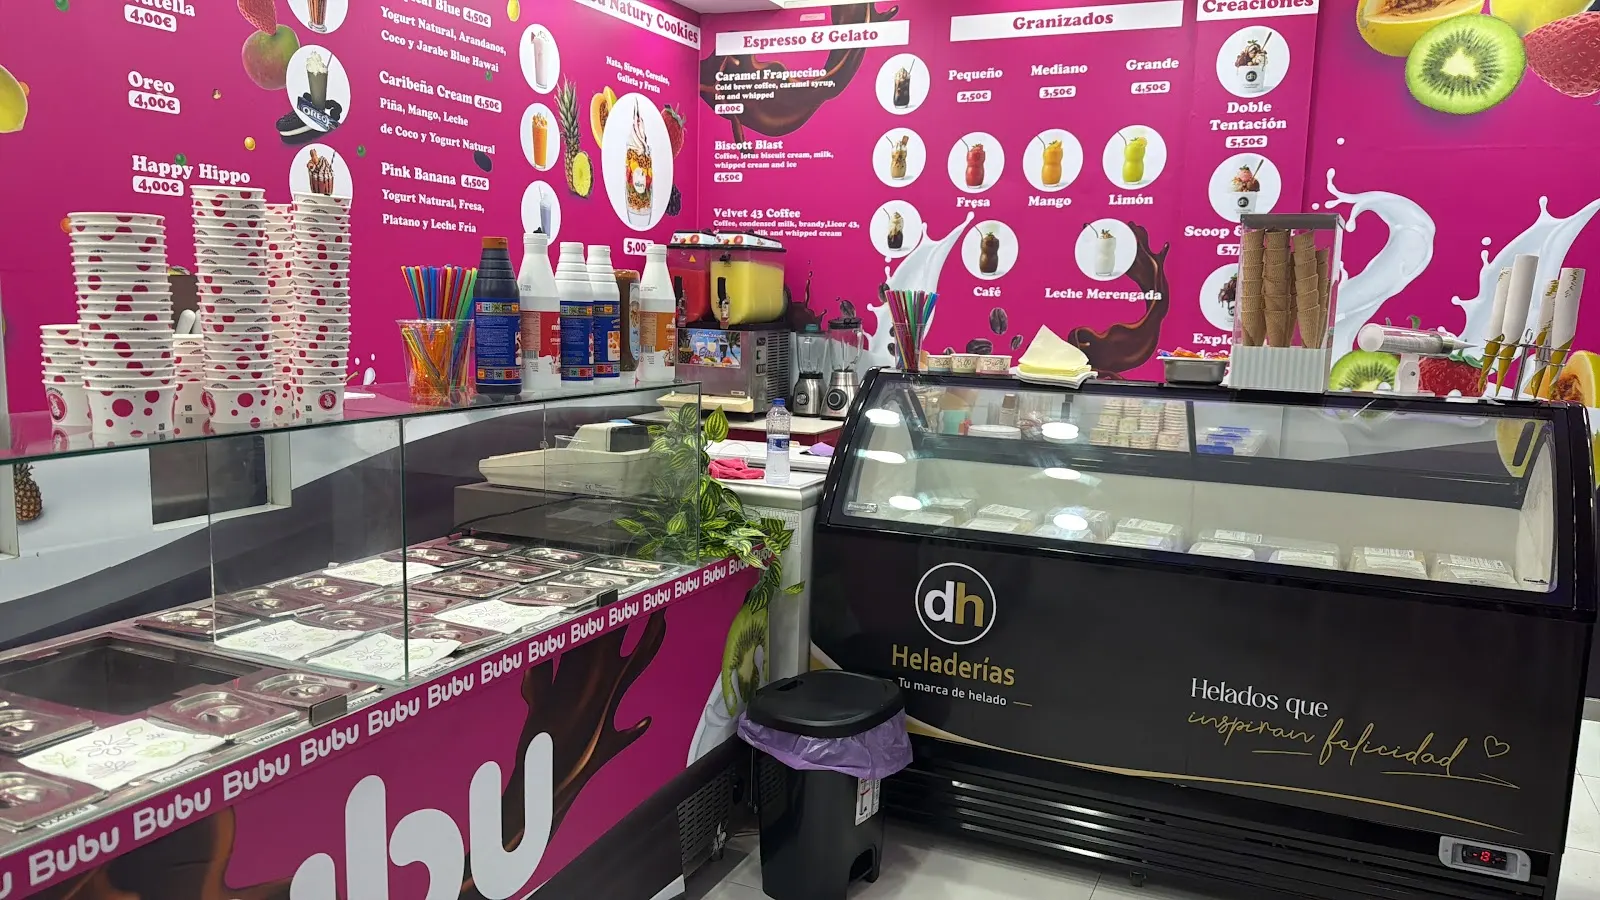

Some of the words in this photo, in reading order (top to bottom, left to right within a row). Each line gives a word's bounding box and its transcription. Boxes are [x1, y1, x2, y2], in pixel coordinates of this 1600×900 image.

[1203, 0, 1314, 13] Creaciones
[130, 9, 172, 28] 4,00€
[466, 11, 488, 24] 4,50€
[1013, 12, 1113, 30] Granizados
[381, 6, 416, 26] Yogurt
[418, 18, 457, 41] Natural,
[459, 31, 506, 56] Arandanos,
[656, 13, 698, 44] Cookies
[743, 36, 807, 50] Espresso
[811, 31, 824, 44] &
[828, 29, 878, 43] Gelato
[381, 30, 406, 45] Coco
[408, 40, 414, 50] y
[416, 40, 448, 58] Jarabe
[450, 49, 470, 64] Blue
[472, 56, 499, 72] Hawai
[606, 56, 623, 71] Nata,
[624, 62, 644, 78] Sirope,
[1031, 64, 1088, 76] Mediano
[1126, 58, 1179, 70] Grande
[715, 70, 760, 81] Caramel
[763, 67, 827, 81] Frapuccino
[948, 67, 1003, 82] Pequeño
[128, 71, 174, 93] Oreo
[379, 70, 434, 95] Caribeña
[437, 85, 472, 104] Cream
[644, 81, 660, 93] Fruta
[715, 83, 732, 91] Cold
[754, 82, 778, 90] coffee,
[780, 80, 810, 88] caramel
[811, 80, 835, 88] syrup,
[1135, 84, 1166, 92] 4,50€
[742, 91, 774, 100] whipped
[961, 93, 987, 101] 2,50€
[1044, 88, 1072, 97] 3,50€
[134, 94, 175, 110] 4,00€
[477, 98, 499, 110] 4,50€
[1227, 101, 1272, 113] Doble
[302, 106, 329, 125] OREO
[380, 97, 405, 115] Piña,
[408, 103, 441, 122] Mango,
[443, 111, 468, 126] Leche
[1209, 117, 1287, 131] Tentación
[380, 123, 393, 134] de
[395, 126, 419, 139] Coco
[421, 133, 427, 143] y
[429, 132, 460, 147] Yogurt
[462, 139, 495, 154] Natural
[715, 141, 753, 150] Biscott
[755, 140, 783, 150] Blast
[1231, 138, 1263, 147] 5,50€
[714, 152, 739, 160] Coffee,
[132, 155, 193, 180] Happy
[199, 163, 250, 185] Hippo
[714, 162, 746, 170] whipped
[381, 162, 411, 178] Pink
[414, 167, 456, 185] Banana
[138, 179, 179, 193] 4,00€
[464, 177, 486, 188] 4,50€
[382, 189, 416, 203] Yogurt
[418, 193, 457, 210] Natural,
[459, 199, 484, 213] Fresa,
[956, 197, 990, 208] Fresa
[1028, 196, 1072, 208] Mango
[1108, 194, 1153, 205] Limón
[713, 208, 748, 218] Velvet
[750, 209, 763, 219] 43
[766, 208, 801, 218] Coffee
[382, 213, 420, 227] Platano
[422, 220, 429, 230] y
[431, 218, 456, 230] Leche
[458, 222, 476, 233] Fria
[777, 220, 797, 228] milk,
[785, 230, 817, 238] whipped
[1184, 226, 1230, 239] Scoop
[627, 241, 652, 253] 5,00
[1221, 246, 1240, 255] 5,7
[973, 286, 1001, 297] Café
[1045, 288, 1083, 299] Leche
[1086, 288, 1162, 302] Merengada
[924, 581, 985, 627] dh
[892, 644, 1015, 686] Heladerías
[898, 677, 910, 688] Tu
[914, 682, 948, 695] marca
[952, 687, 965, 698] de
[969, 690, 1006, 705] helado
[1191, 678, 1278, 710] Helados
[1286, 698, 1328, 720] que
[29, 826, 120, 887] Bubu
[133, 787, 211, 841] Bubu
[222, 753, 291, 801] Bubu
[301, 724, 359, 767] Bubu
[368, 696, 420, 736] Bubu
[428, 672, 474, 709] Bubu
[481, 650, 522, 685] Bubu
[528, 633, 565, 662] Bubu
[570, 615, 605, 644] Bubu
[608, 600, 639, 627] Bubu
[643, 587, 671, 612] Bubu
[675, 575, 700, 598] Bubu
[703, 565, 726, 586] Bubu
[1188, 711, 1316, 746] inspiran
[1319, 718, 1469, 777] felicidad
